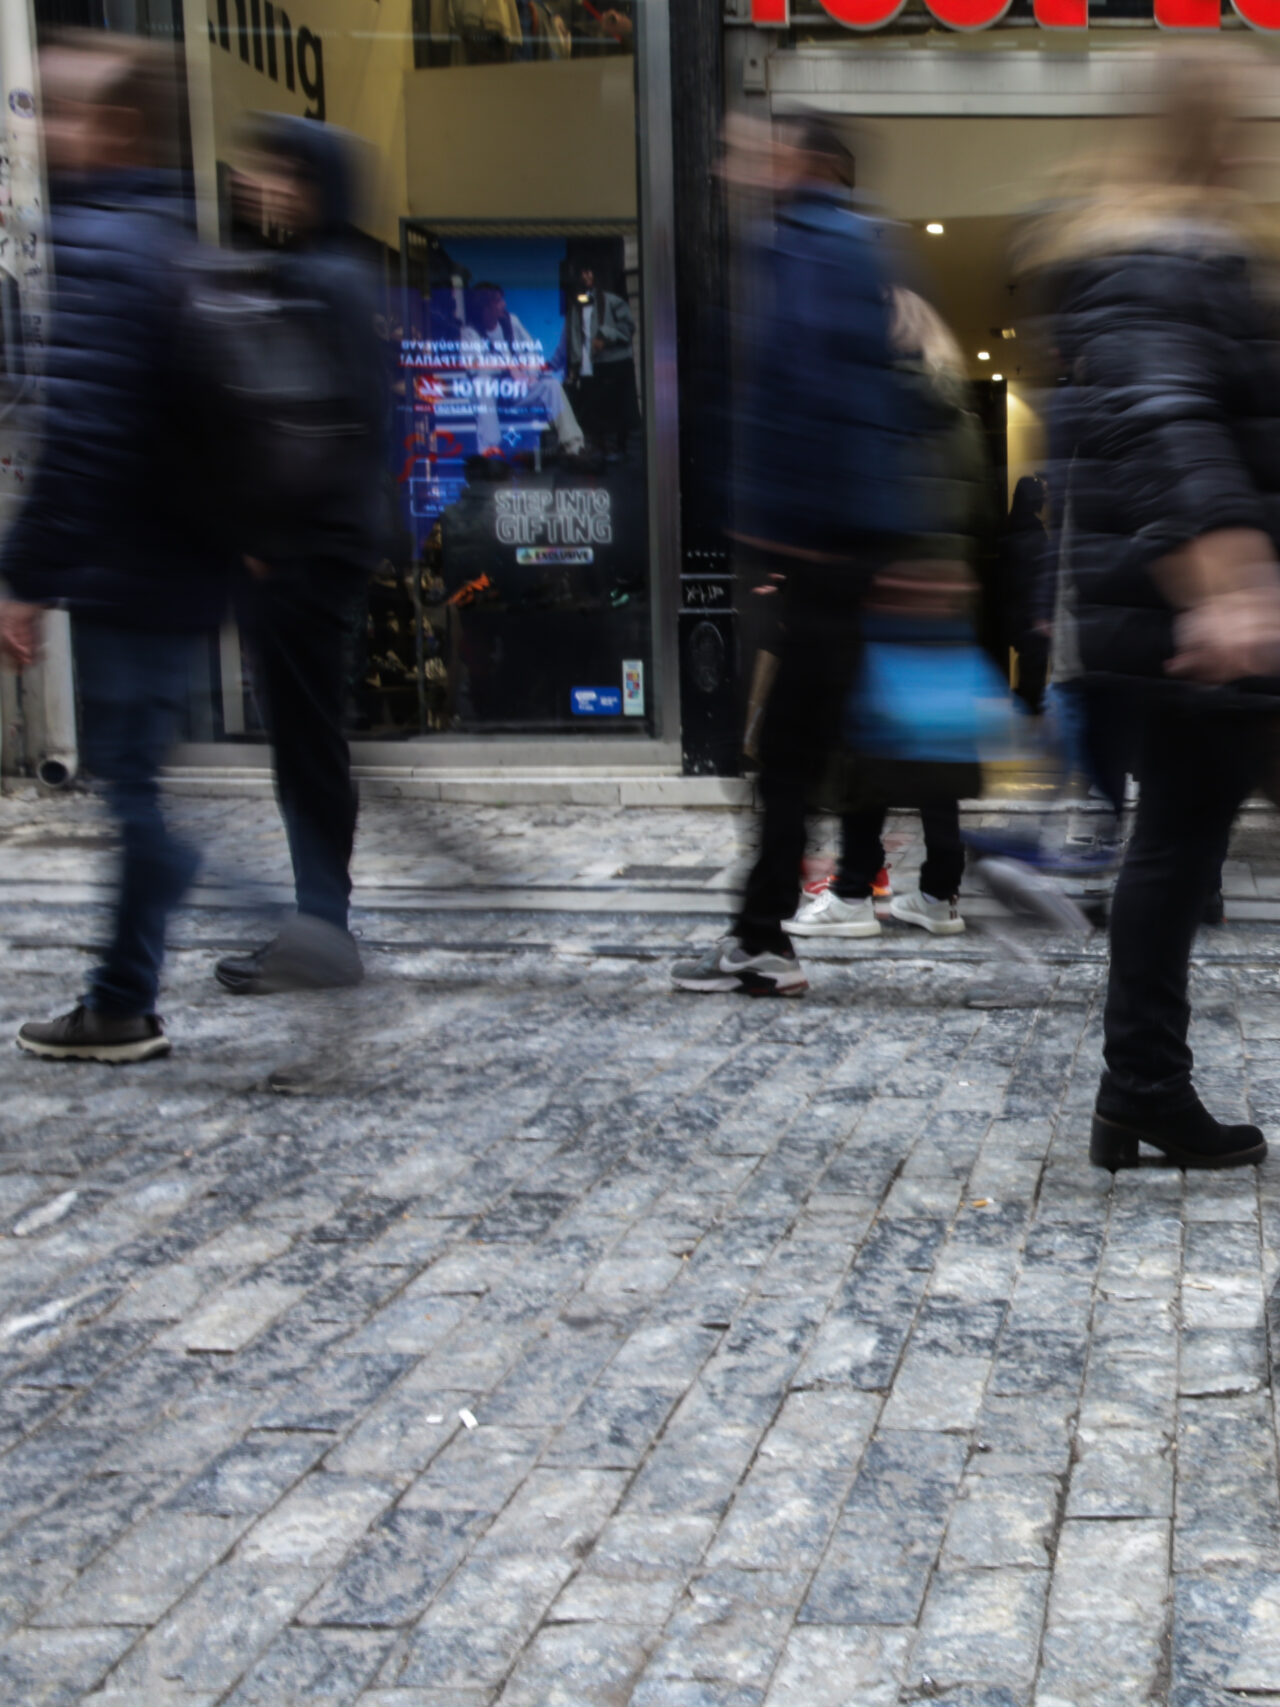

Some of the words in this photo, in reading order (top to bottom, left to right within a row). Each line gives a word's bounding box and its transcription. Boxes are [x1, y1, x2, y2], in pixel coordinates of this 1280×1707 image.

[495, 489, 553, 514] STEP
[555, 488, 611, 514] INTO
[496, 513, 612, 544] GIFTING
